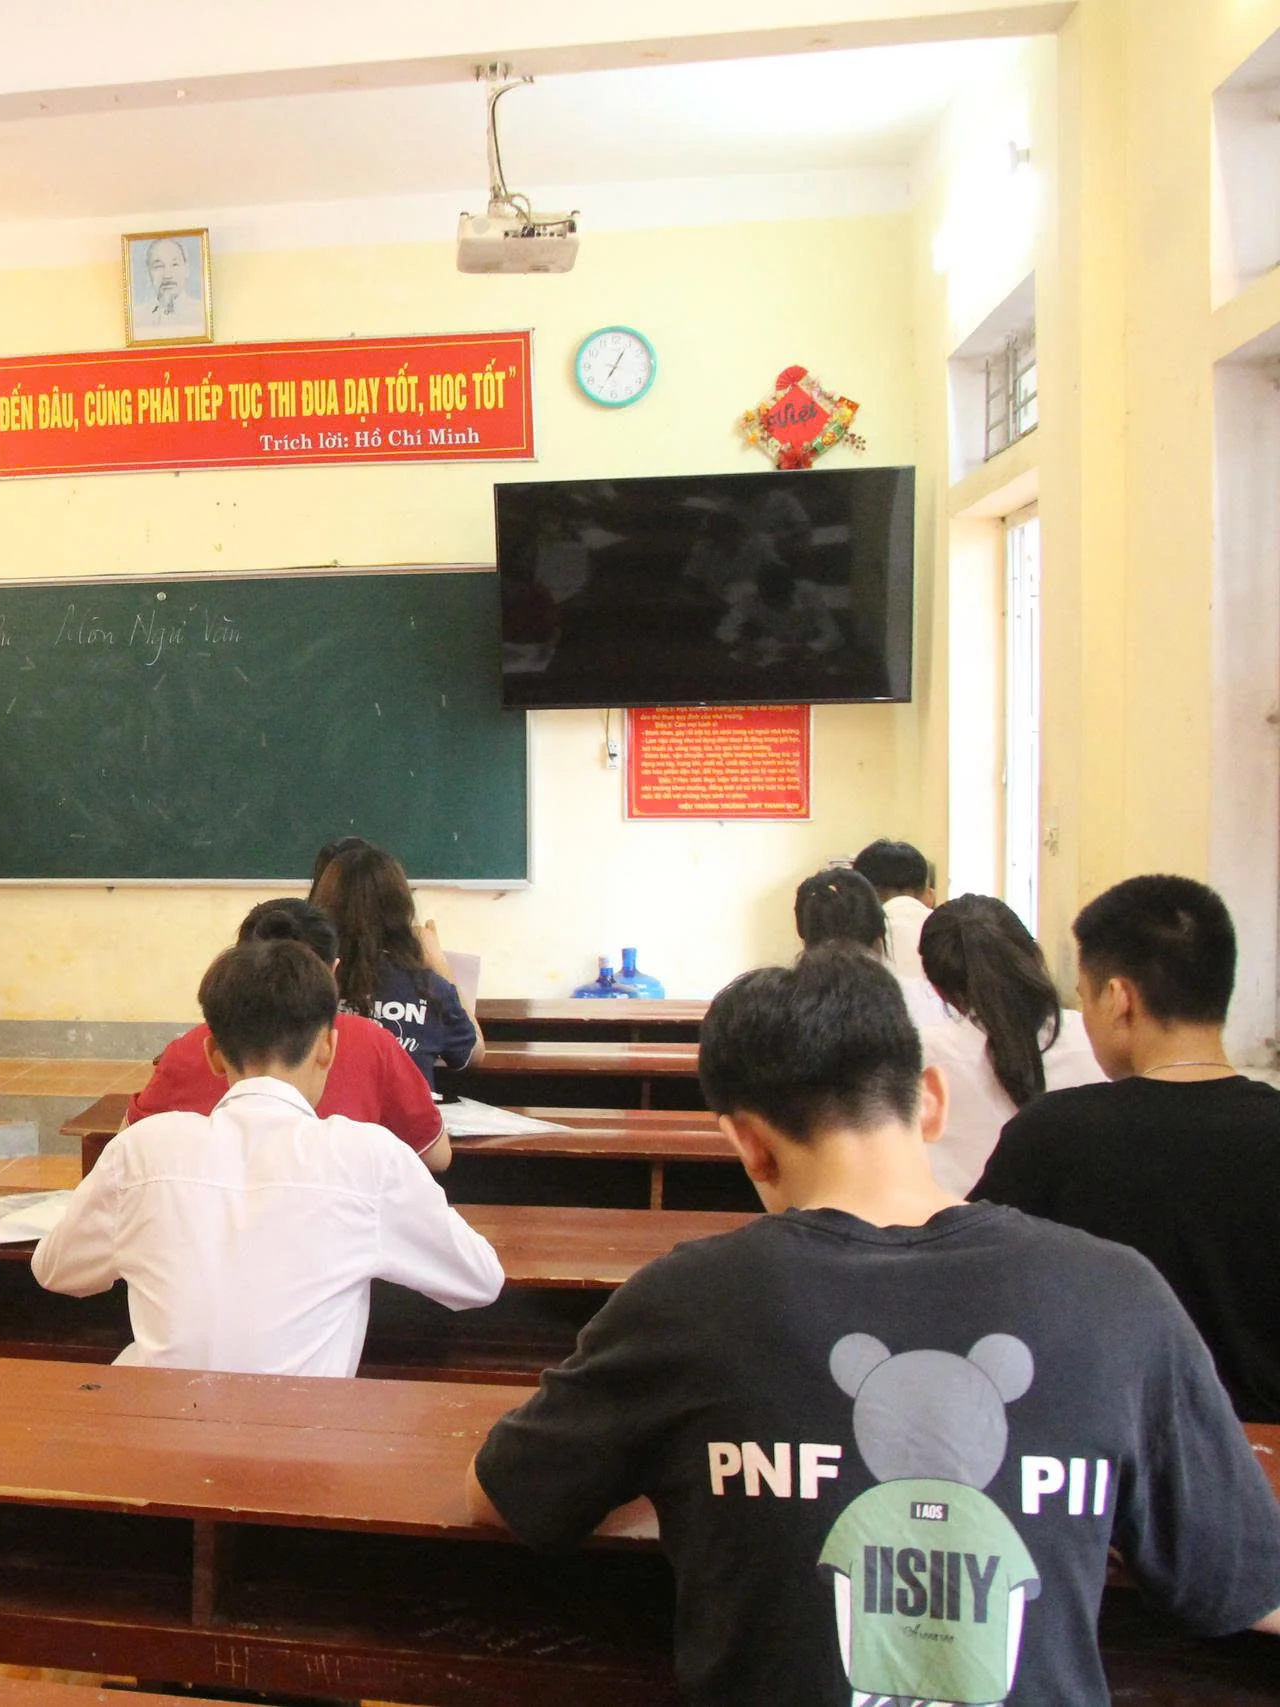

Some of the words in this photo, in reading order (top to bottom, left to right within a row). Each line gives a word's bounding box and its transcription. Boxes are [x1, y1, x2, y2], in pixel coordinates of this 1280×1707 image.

[0, 383, 34, 432] ĐẾN
[38, 386, 79, 432] ĐÂU,
[84, 384, 133, 427] CŨNG
[138, 371, 179, 424] PHẢI
[184, 371, 223, 422] TIẾP
[229, 382, 263, 428] TỤC
[268, 381, 296, 418] THI
[302, 379, 339, 416] ĐUA
[344, 377, 380, 422] DẠY
[385, 362, 424, 416] TỐT,
[429, 373, 467, 420] HỌC
[260, 434, 312, 451] Trích
[318, 432, 350, 449] lời:
[355, 428, 382, 448] Hồ
[388, 429, 422, 446] Chí
[429, 427, 480, 445] Minh
[708, 1442, 841, 1499] PNF
